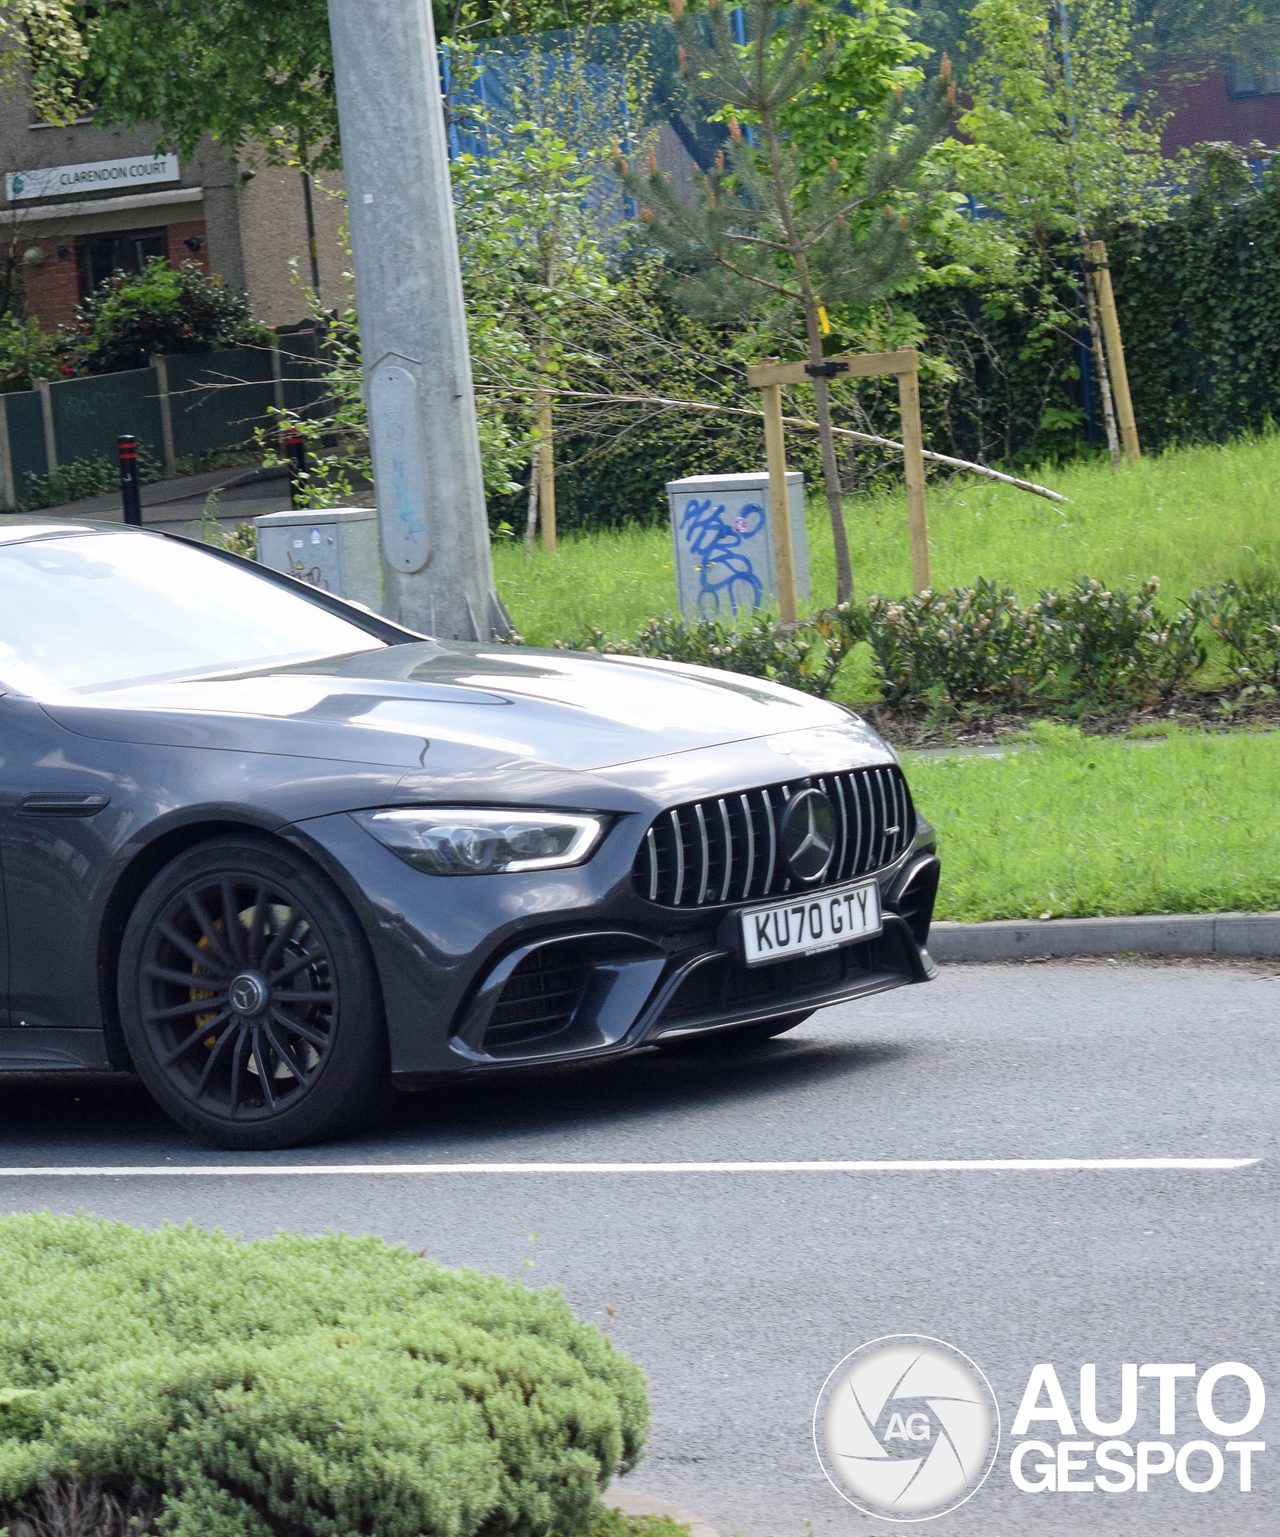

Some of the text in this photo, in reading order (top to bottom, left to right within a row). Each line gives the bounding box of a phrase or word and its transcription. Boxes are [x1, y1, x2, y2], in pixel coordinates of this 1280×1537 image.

[59, 166, 128, 186] CLARENDON
[129, 161, 167, 178] COURT
[755, 890, 867, 951] KU70 GTY
